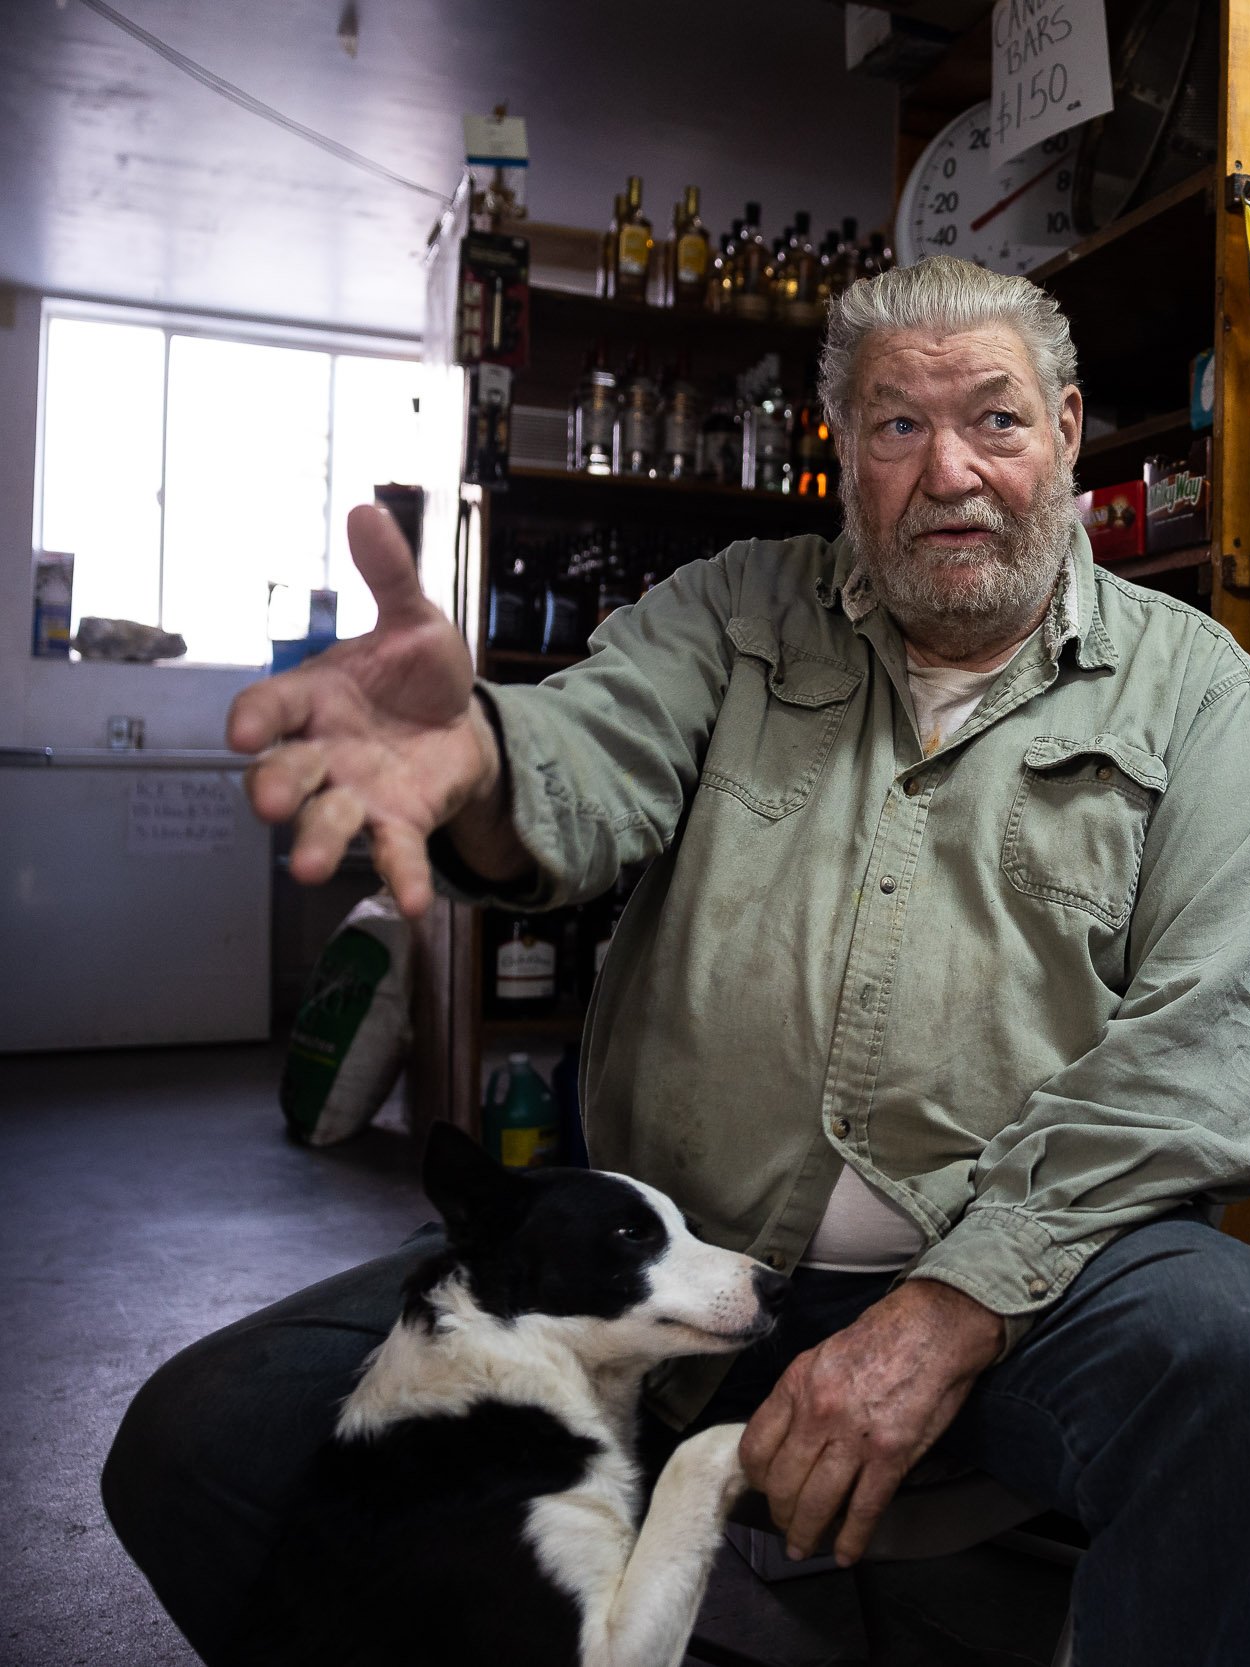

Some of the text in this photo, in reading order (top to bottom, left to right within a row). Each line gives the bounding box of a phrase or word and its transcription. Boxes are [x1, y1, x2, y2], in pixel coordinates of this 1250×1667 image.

[995, 0, 1044, 47] CAN
[1006, 5, 1073, 75] BARS
[942, 157, 957, 178] 0
[928, 191, 959, 215] -20
[1047, 211, 1070, 234] 10
[927, 224, 957, 246] -40
[1174, 470, 1203, 506] Way
